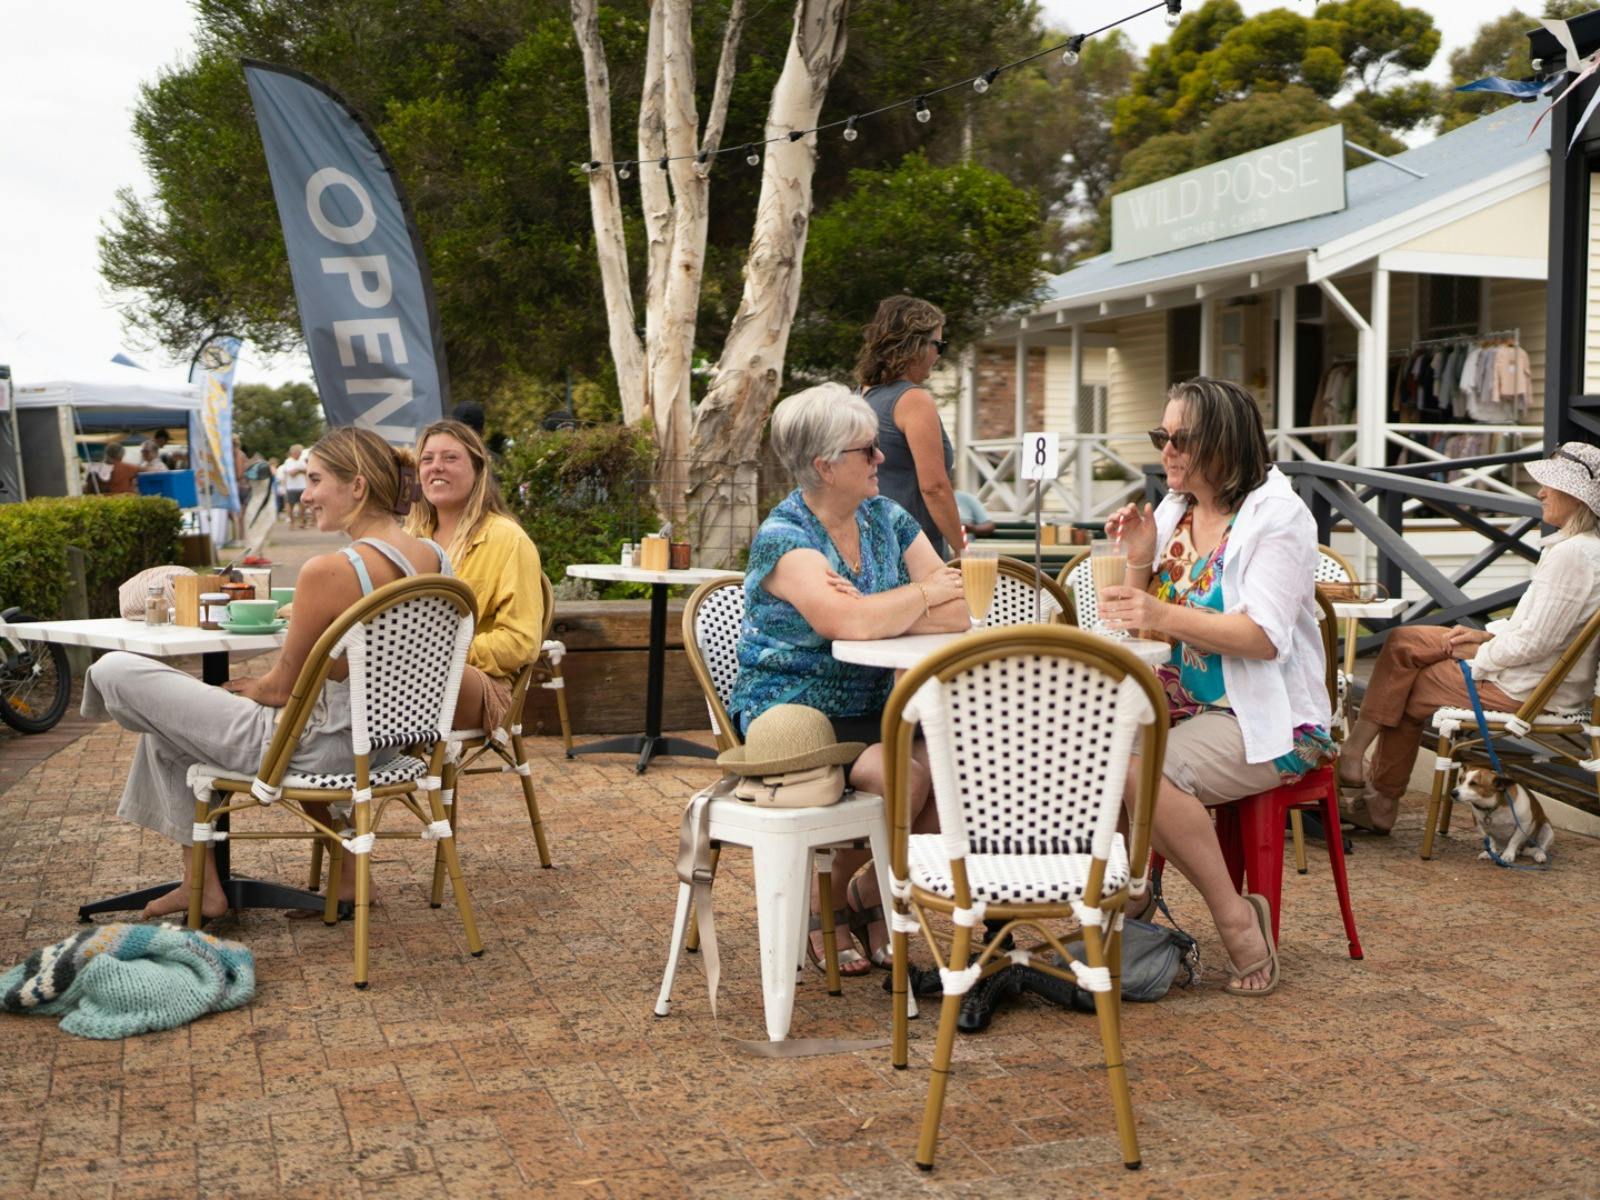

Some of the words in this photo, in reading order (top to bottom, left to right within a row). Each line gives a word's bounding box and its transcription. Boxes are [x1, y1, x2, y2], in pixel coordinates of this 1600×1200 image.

[1128, 178, 1201, 230] WILD
[1213, 140, 1319, 210] POSSE
[304, 166, 418, 443] OPEN
[1035, 436, 1046, 466] 8
